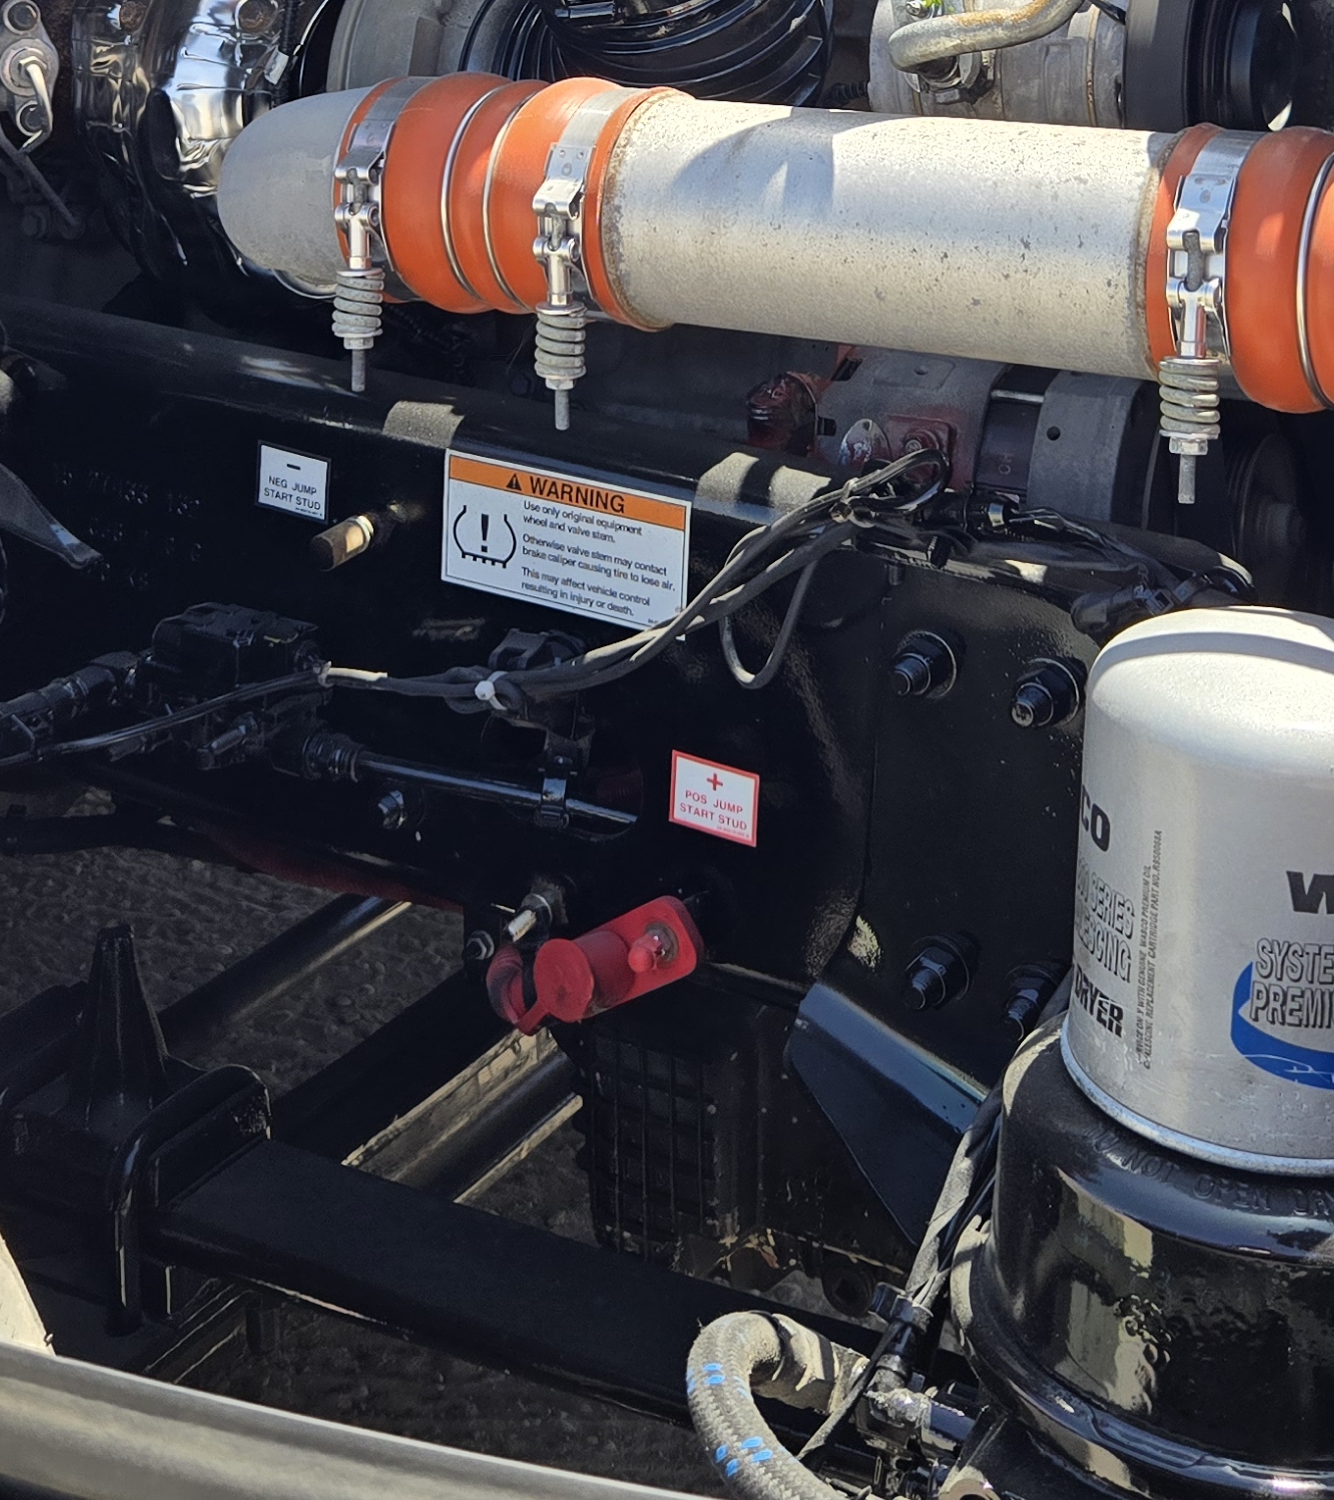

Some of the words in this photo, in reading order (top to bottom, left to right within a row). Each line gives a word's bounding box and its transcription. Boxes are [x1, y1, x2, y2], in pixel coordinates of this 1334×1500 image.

[264, 487, 293, 503] START
[295, 496, 321, 510] STUD
[269, 475, 288, 488] NEG
[292, 482, 317, 495] JUMP
[529, 476, 625, 513] WARNING
[523, 514, 548, 528] wheel
[549, 519, 565, 532] and
[567, 523, 590, 537] valve
[592, 531, 615, 543] stem.
[524, 500, 541, 513] Use
[542, 505, 560, 519] only
[562, 510, 595, 527] original
[596, 517, 643, 536] equipment
[522, 533, 565, 551] Otherwise
[567, 544, 589, 558] valve
[591, 551, 612, 562] stem
[614, 556, 633, 570] may
[634, 561, 667, 576] contact
[522, 546, 546, 560] brake
[548, 553, 576, 567] caliper
[578, 560, 612, 578] causing
[613, 568, 628, 580] tire
[630, 572, 639, 583] to
[641, 574, 660, 587] lose
[661, 579, 676, 592] air.
[521, 566, 540, 579] This
[541, 572, 559, 585] may
[560, 577, 585, 591] affect
[586, 583, 617, 598] vehicle
[618, 590, 650, 607] control
[521, 581, 558, 599] resulting
[560, 587, 568, 598] in
[570, 591, 594, 608] injury
[595, 599, 606, 608] or
[607, 601, 634, 616] death.
[680, 802, 715, 821] START
[718, 814, 747, 830] STUD
[685, 790, 707, 805] POS
[713, 799, 743, 814] JUMP
[1142, 864, 1152, 878] OIL
[1091, 872, 1135, 939] SERIES
[1141, 878, 1151, 918] PREMIUM
[1150, 888, 1160, 911] PART
[1139, 919, 1149, 948] WABCO
[1147, 911, 1158, 959] CARTRIDGE
[1137, 950, 1147, 986] GENUINE
[1073, 964, 1124, 1038] DRYER
[1137, 988, 1146, 1007] WITH
[1145, 960, 1156, 1019] REPLACEMENT
[1122, 1147, 1180, 1184] NOT
